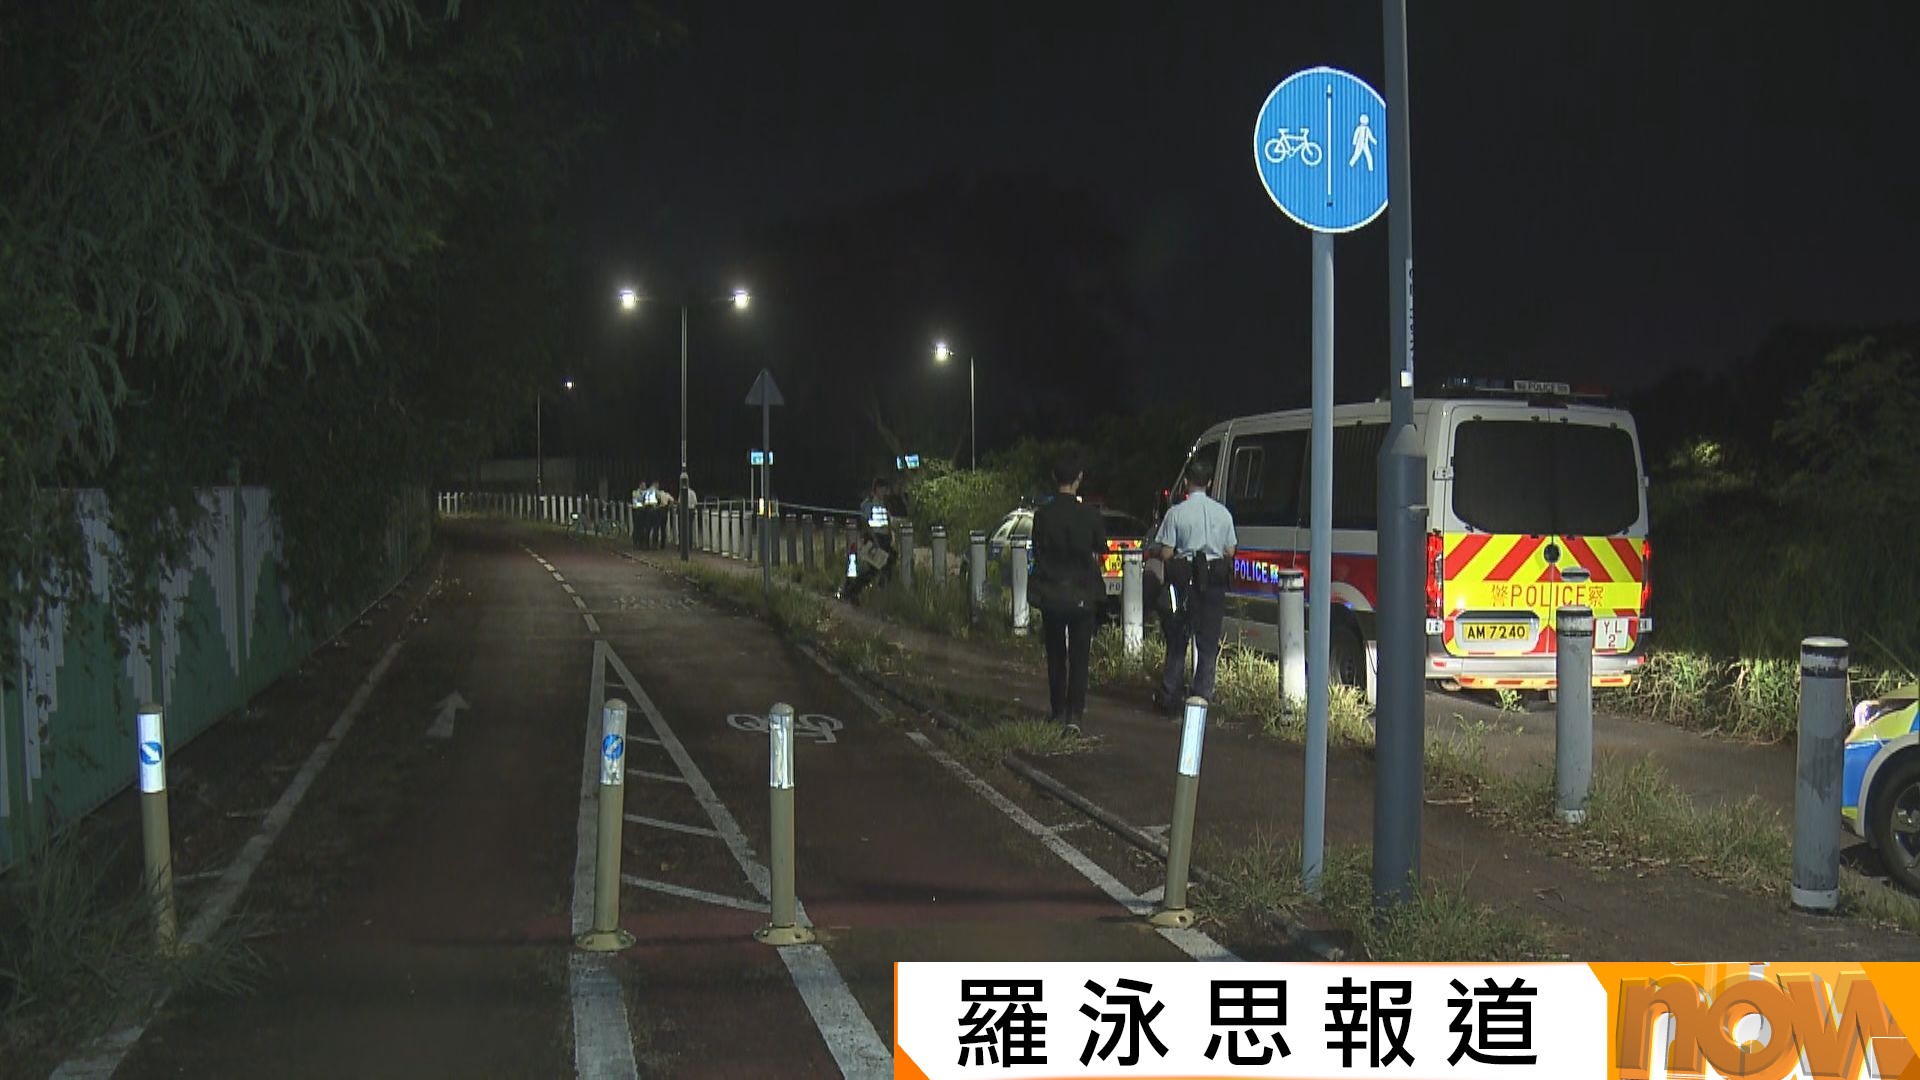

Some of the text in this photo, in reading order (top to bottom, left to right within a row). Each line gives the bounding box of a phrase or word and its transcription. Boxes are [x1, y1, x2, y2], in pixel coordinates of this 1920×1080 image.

[1234, 559, 1268, 583] POLICE
[1467, 625, 1526, 640] AM 7240
[1608, 633, 1616, 648] 2
